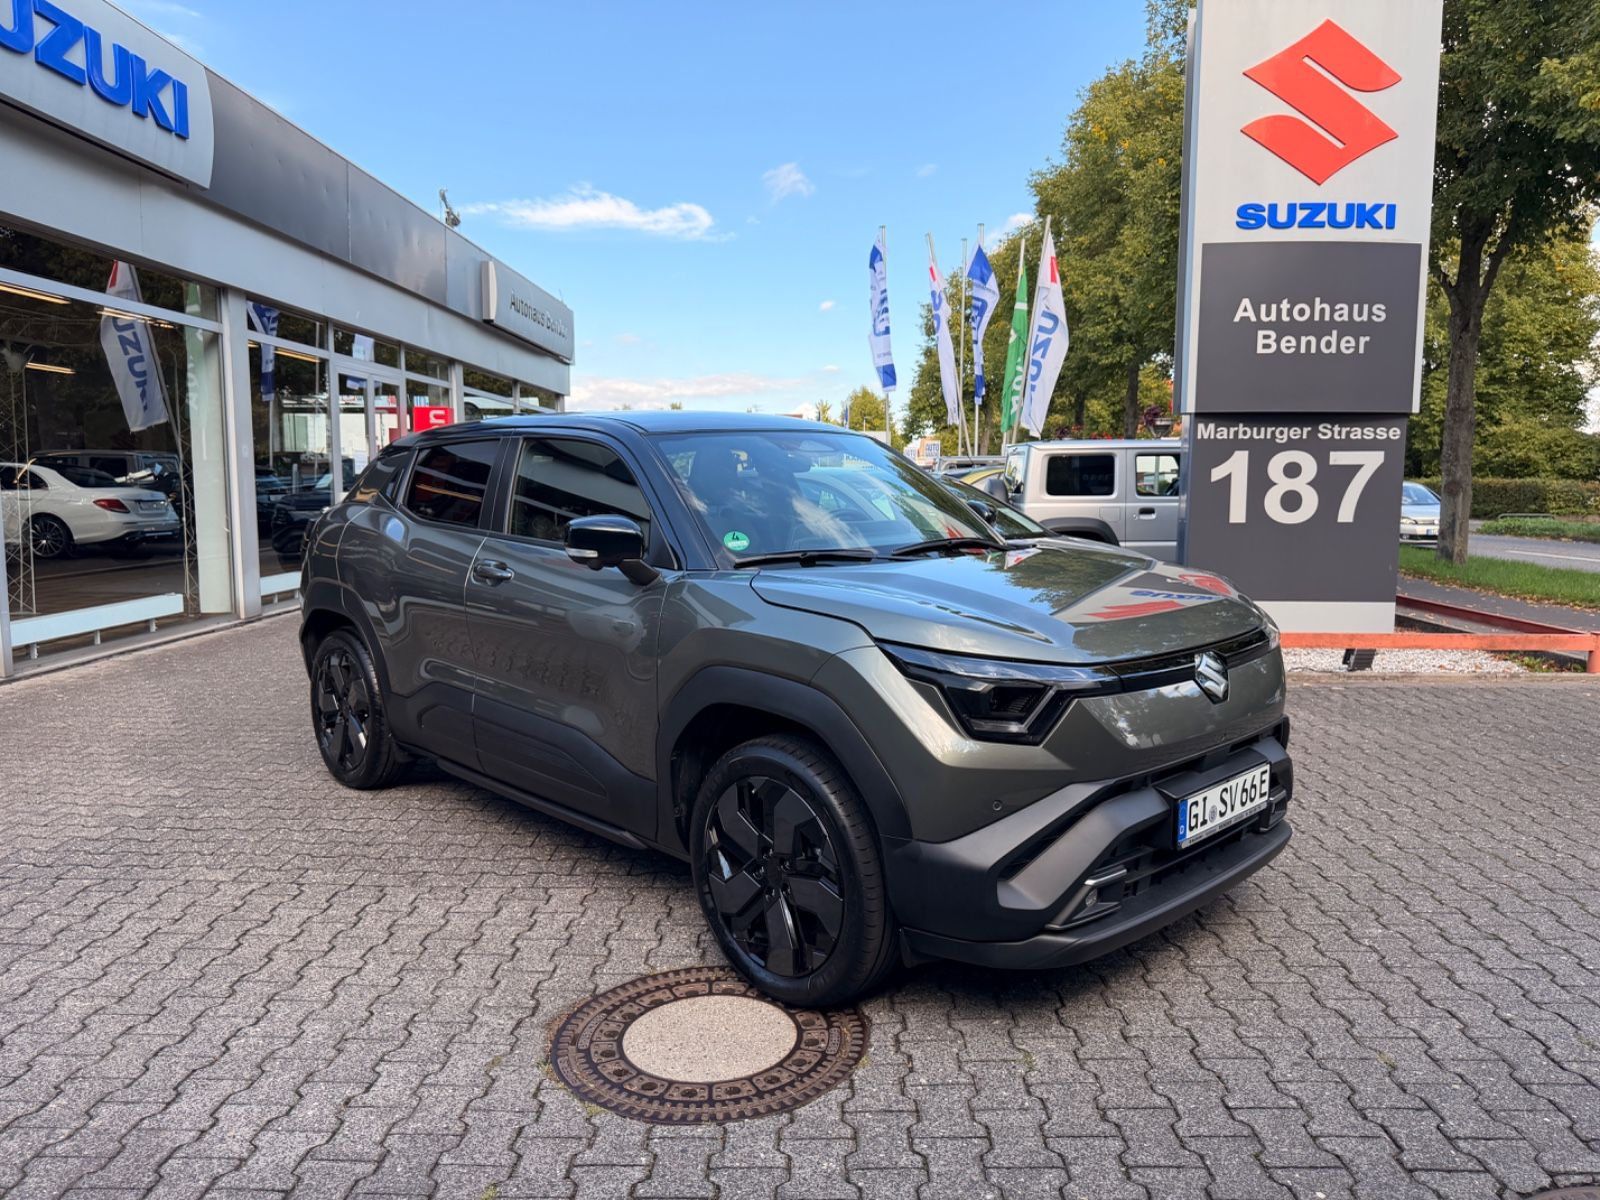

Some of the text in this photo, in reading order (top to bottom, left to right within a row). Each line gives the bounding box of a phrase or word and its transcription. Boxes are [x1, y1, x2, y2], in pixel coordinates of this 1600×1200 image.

[1236, 202, 1397, 230] SUZUKI
[1233, 297, 1386, 323] Autohaus
[1257, 330, 1371, 355] Bender
[1197, 424, 1401, 443] Marburger Strasse
[1210, 450, 1385, 524] 187
[1188, 796, 1208, 832] GI
